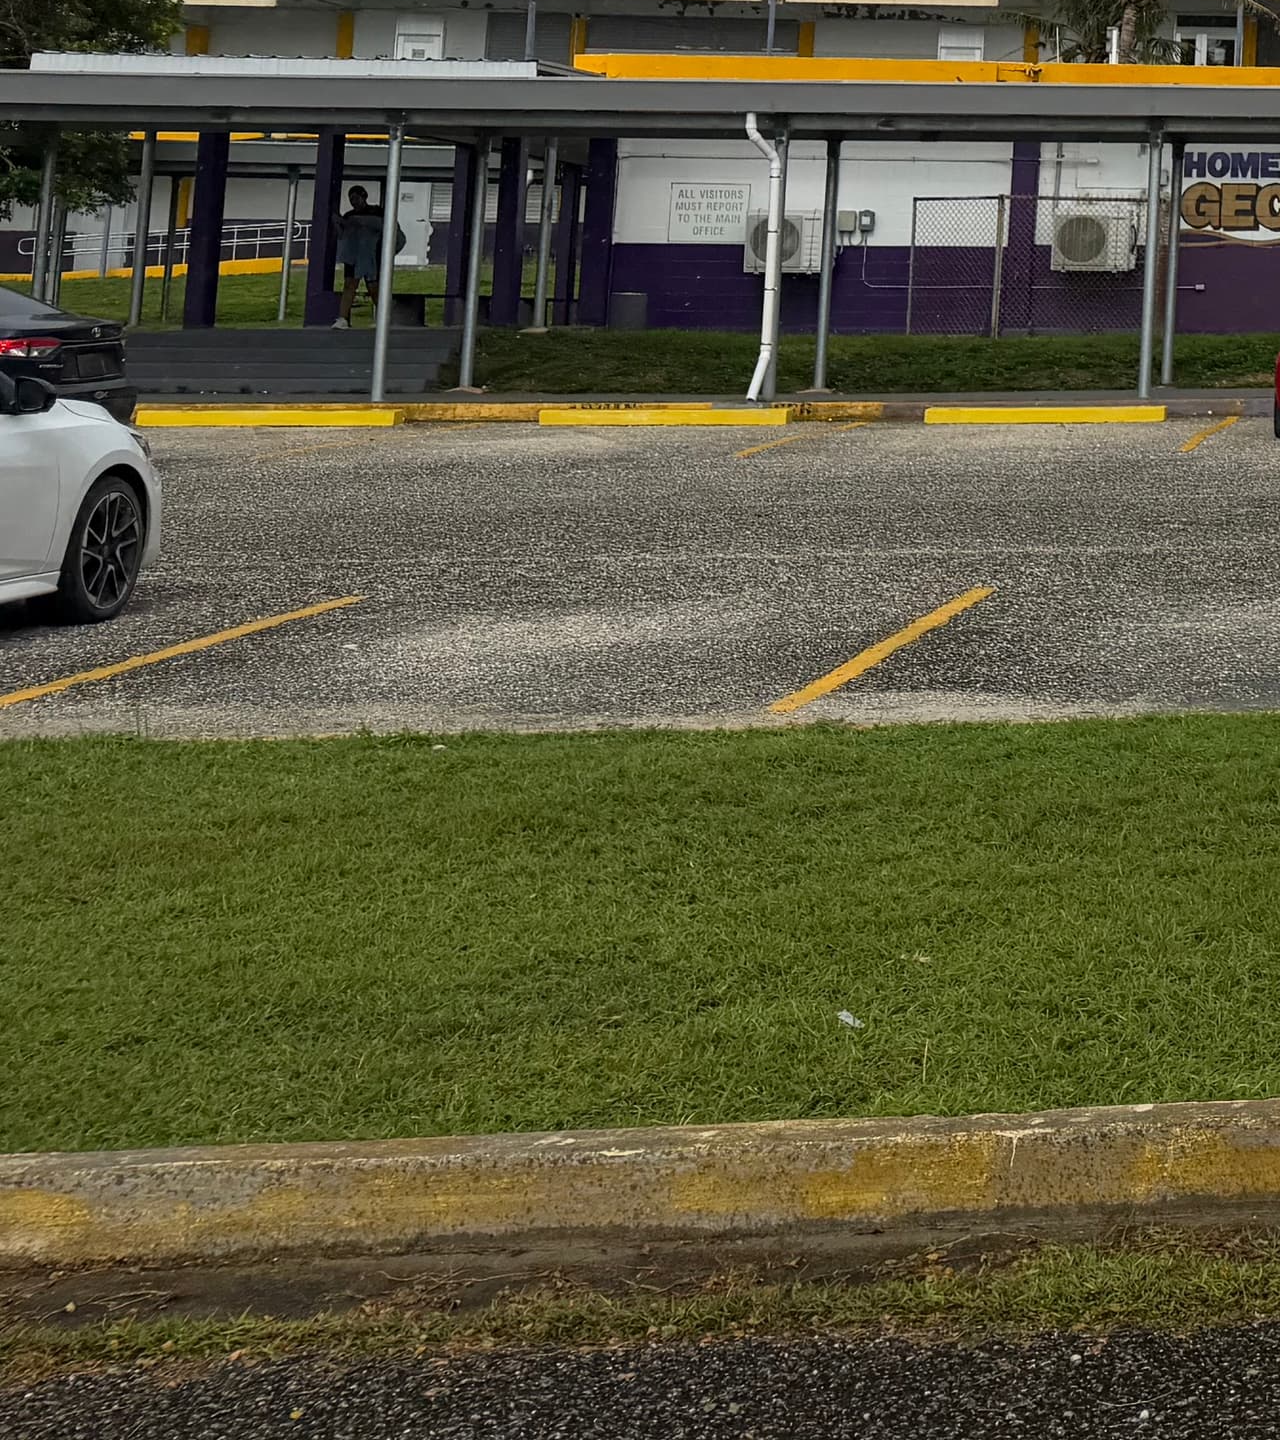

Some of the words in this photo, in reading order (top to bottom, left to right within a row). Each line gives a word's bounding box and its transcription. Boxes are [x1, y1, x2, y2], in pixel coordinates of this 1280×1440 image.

[678, 189, 695, 199] ALL
[700, 190, 744, 200] VISITORS
[675, 202, 702, 211] MUST
[706, 202, 744, 212] REPORT
[678, 214, 690, 223] TO
[694, 214, 712, 223] THE
[715, 214, 741, 224] MAIN
[692, 226, 726, 236] OFFICE
